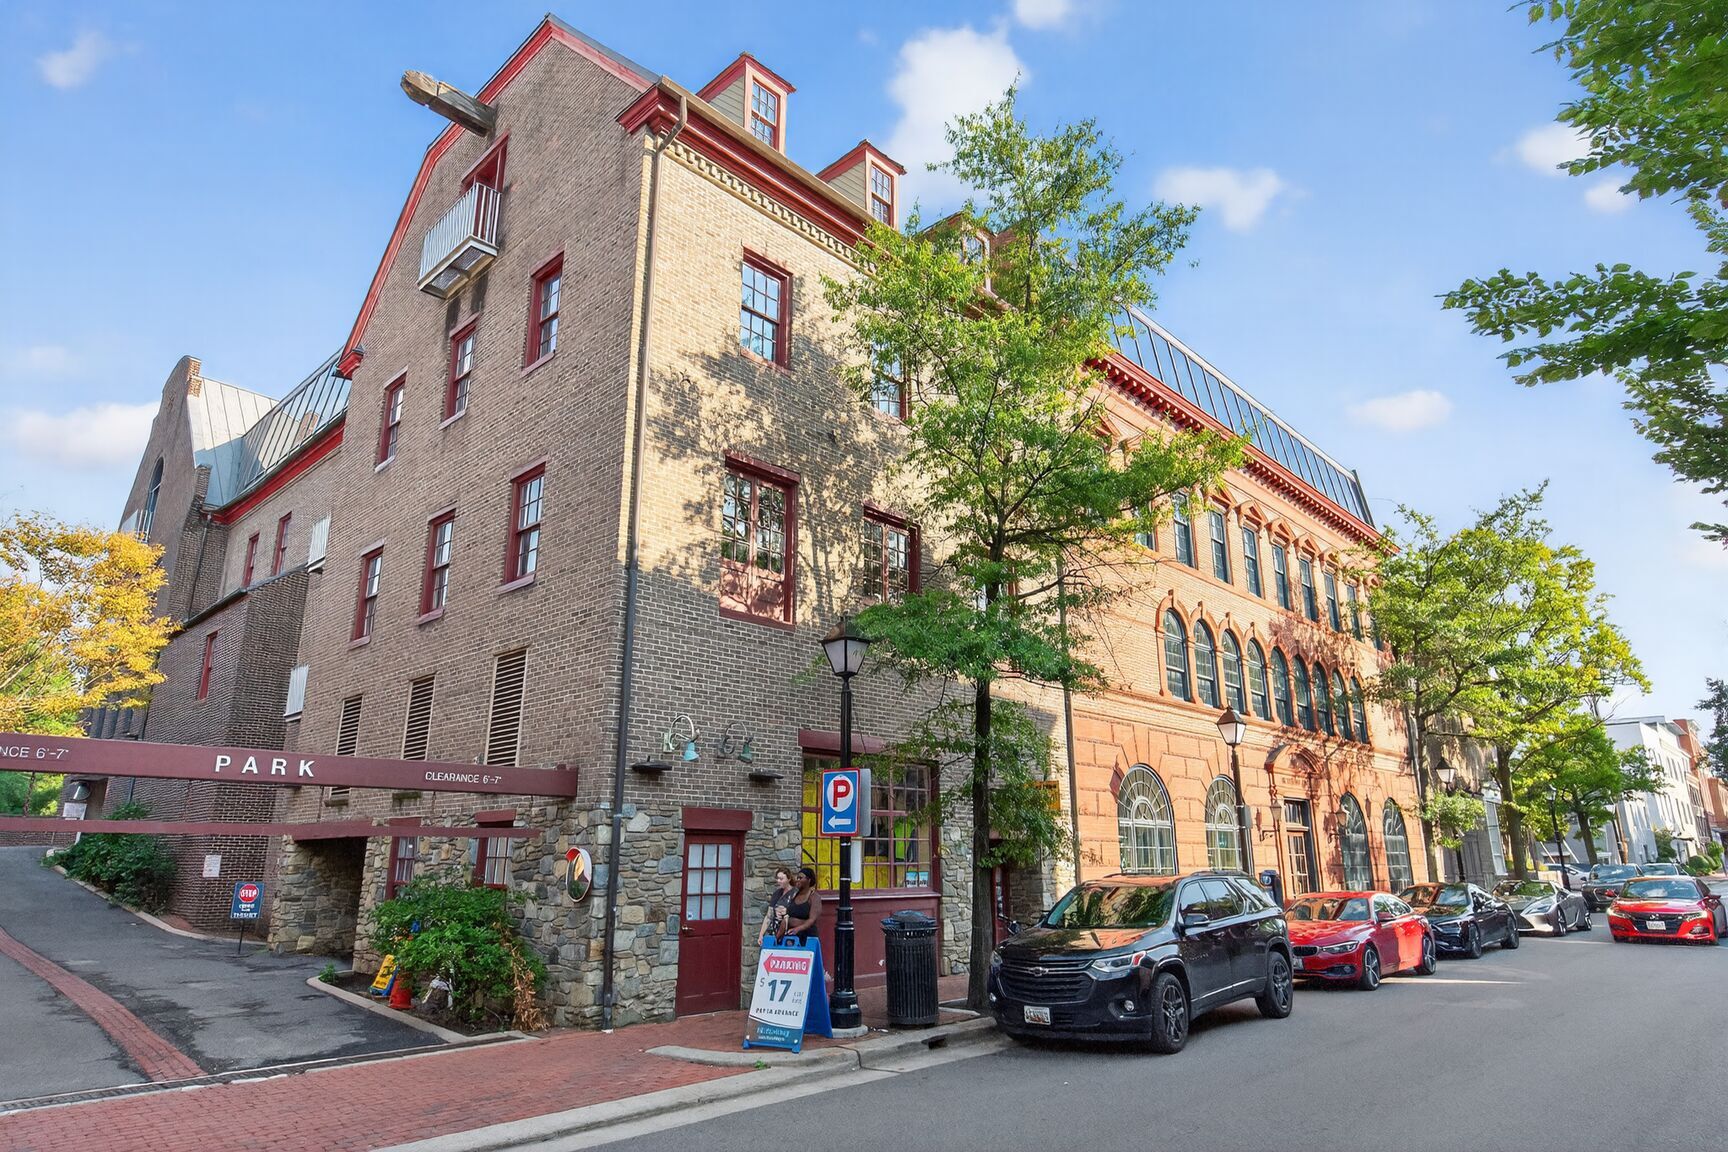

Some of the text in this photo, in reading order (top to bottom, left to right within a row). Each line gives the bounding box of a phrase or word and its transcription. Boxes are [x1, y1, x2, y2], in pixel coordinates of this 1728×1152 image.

[215, 755, 315, 777] PARK
[425, 771, 480, 783] CLEARANCE
[833, 779, 851, 808] P
